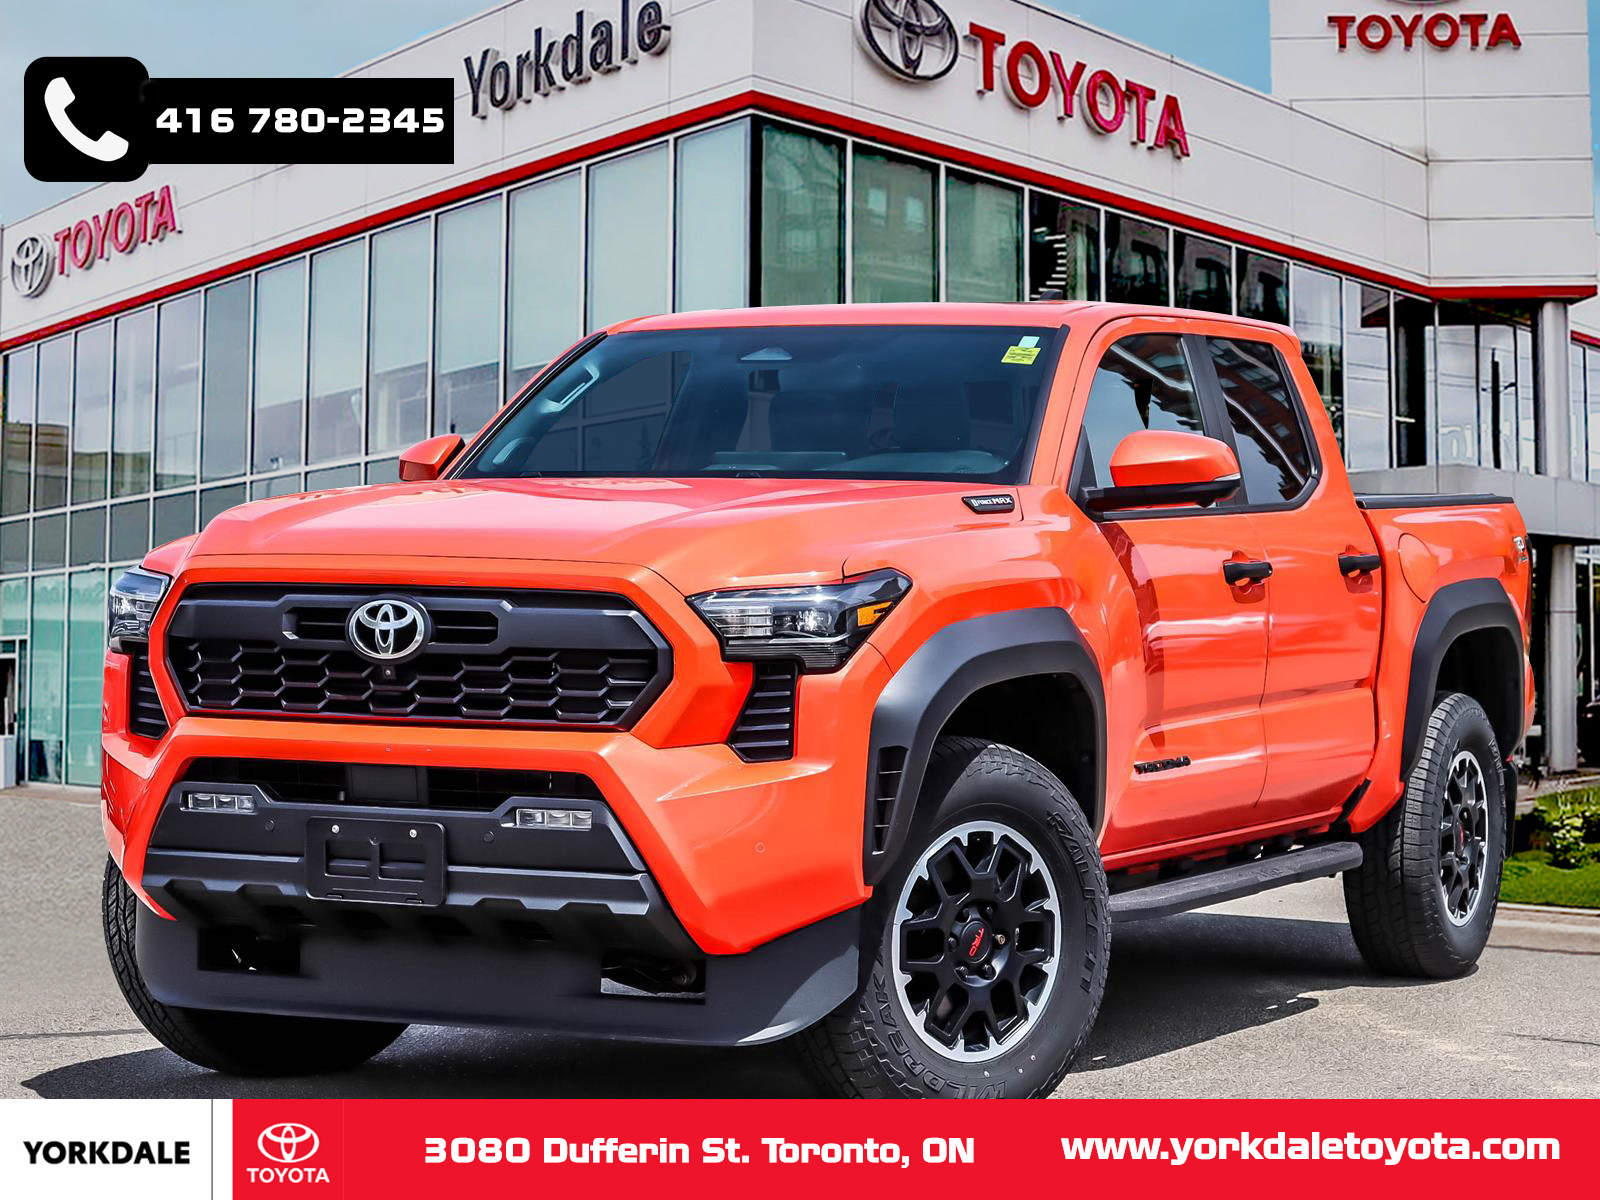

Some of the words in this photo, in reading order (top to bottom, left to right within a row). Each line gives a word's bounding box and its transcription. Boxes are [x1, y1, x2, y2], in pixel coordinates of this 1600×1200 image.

[464, 0, 671, 119] Yorkdale
[1327, 13, 1522, 51] TOYOTA
[967, 21, 1191, 158] TOYOTA
[54, 185, 177, 276] TOYOTA
[991, 497, 1013, 505] MAX
[968, 928, 985, 957] TRD
[872, 972, 1007, 1099] WILDPEAK
